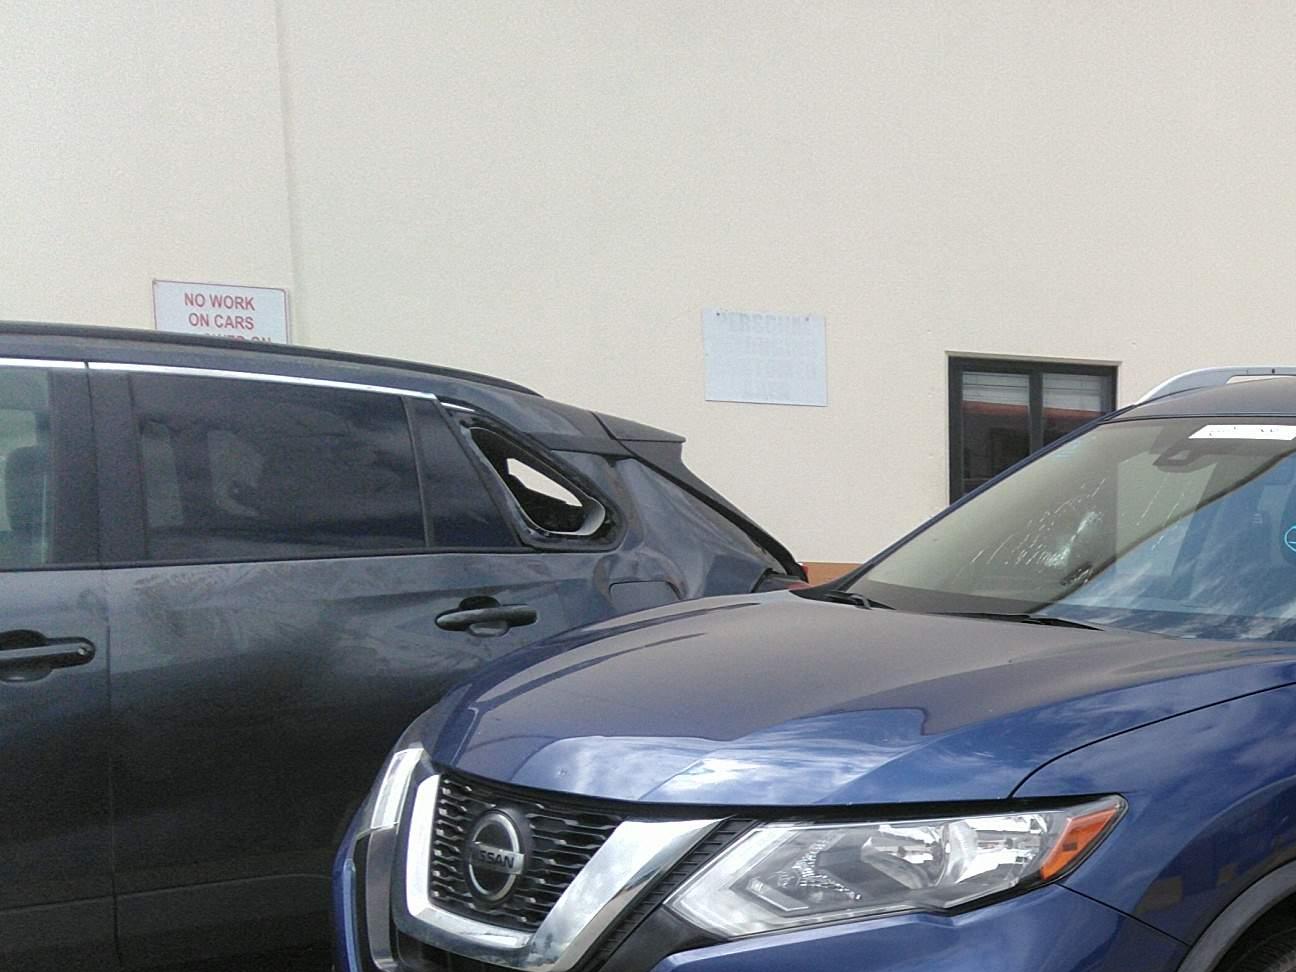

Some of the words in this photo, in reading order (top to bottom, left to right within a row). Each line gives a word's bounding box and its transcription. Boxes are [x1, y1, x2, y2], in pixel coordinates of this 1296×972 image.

[184, 292, 205, 307] NO
[209, 293, 255, 311] WORK
[188, 312, 209, 327] ON
[214, 314, 254, 330] CARS
[472, 848, 515, 869] SSAN
